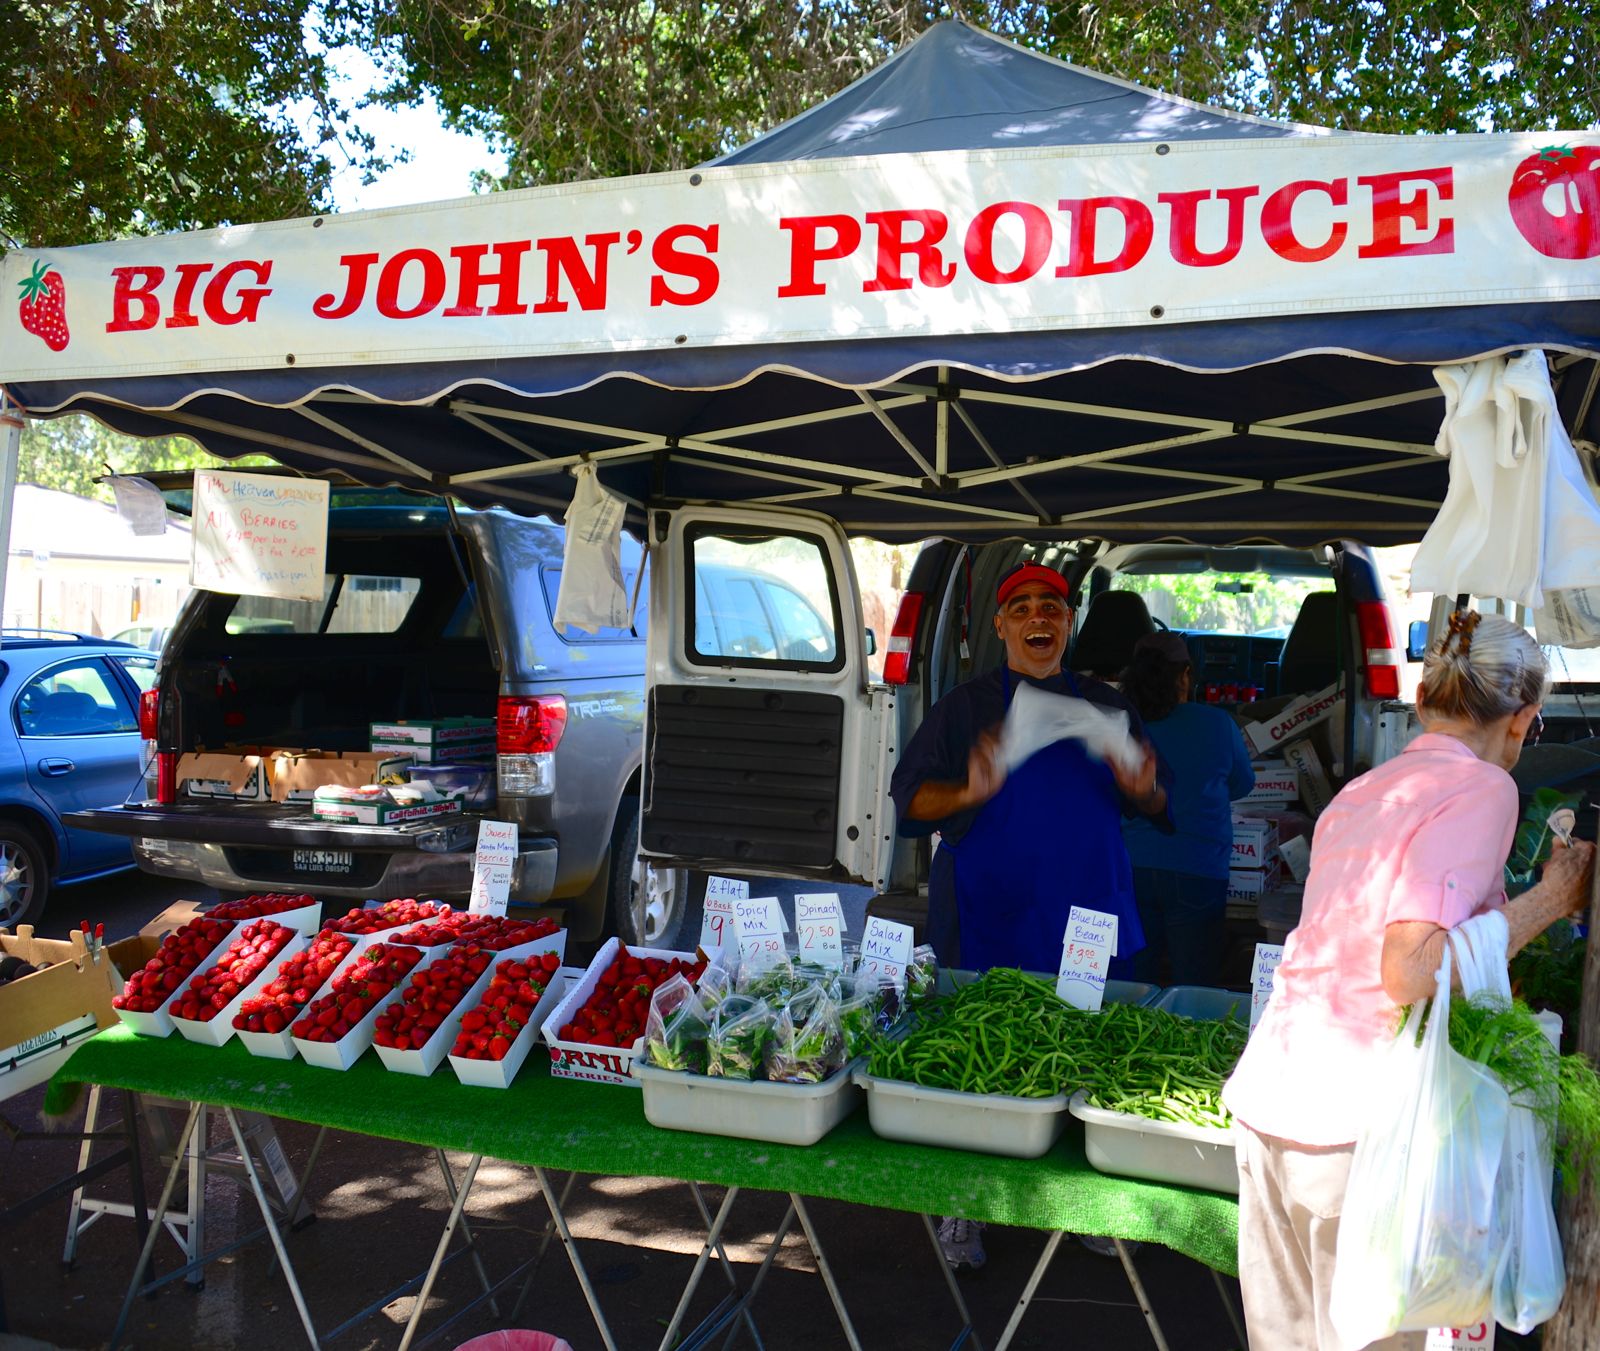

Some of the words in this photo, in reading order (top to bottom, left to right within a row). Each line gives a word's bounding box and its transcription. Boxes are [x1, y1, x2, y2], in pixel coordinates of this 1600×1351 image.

[106, 260, 273, 333] BIG
[313, 223, 721, 320] JOHN'S
[777, 165, 1455, 299] PRODUCE
[240, 506, 297, 531] BERRIES
[569, 700, 600, 719] TRD
[484, 823, 514, 840] Sweet
[478, 851, 511, 864] Berries
[294, 863, 307, 871] SAN
[309, 863, 323, 872] LUIS
[324, 864, 350, 874] OBISPO
[719, 879, 745, 899] flat
[736, 902, 768, 920] Spicy
[798, 896, 839, 917] Spinach
[743, 920, 767, 931] Mix
[1071, 909, 1090, 924] Blue
[1092, 914, 1114, 930] Lake
[870, 919, 904, 944] Salad
[1075, 926, 1105, 943] Beans
[866, 940, 894, 959] Mix
[17, 1030, 57, 1054] VEGETABLES
[552, 1068, 624, 1084] BERRIES
